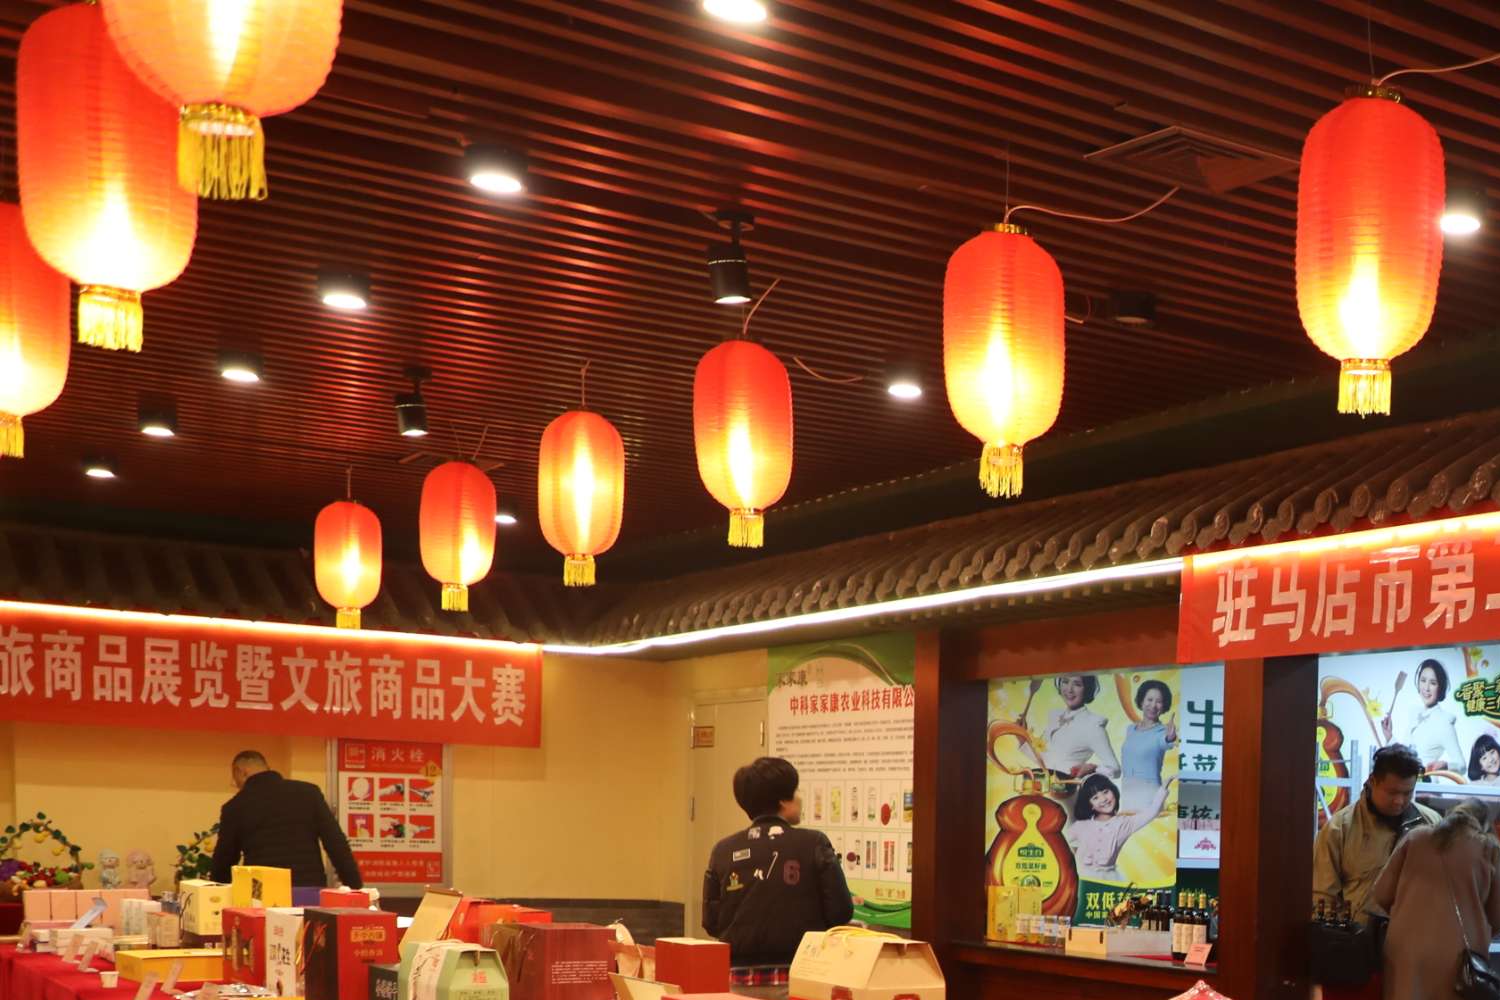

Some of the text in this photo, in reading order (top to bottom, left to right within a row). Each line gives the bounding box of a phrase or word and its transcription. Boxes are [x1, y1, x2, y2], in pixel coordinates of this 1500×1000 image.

[0, 624, 526, 728] 旅商品展览暨文旅商品大赛
[371, 747, 424, 762] 消火栓
